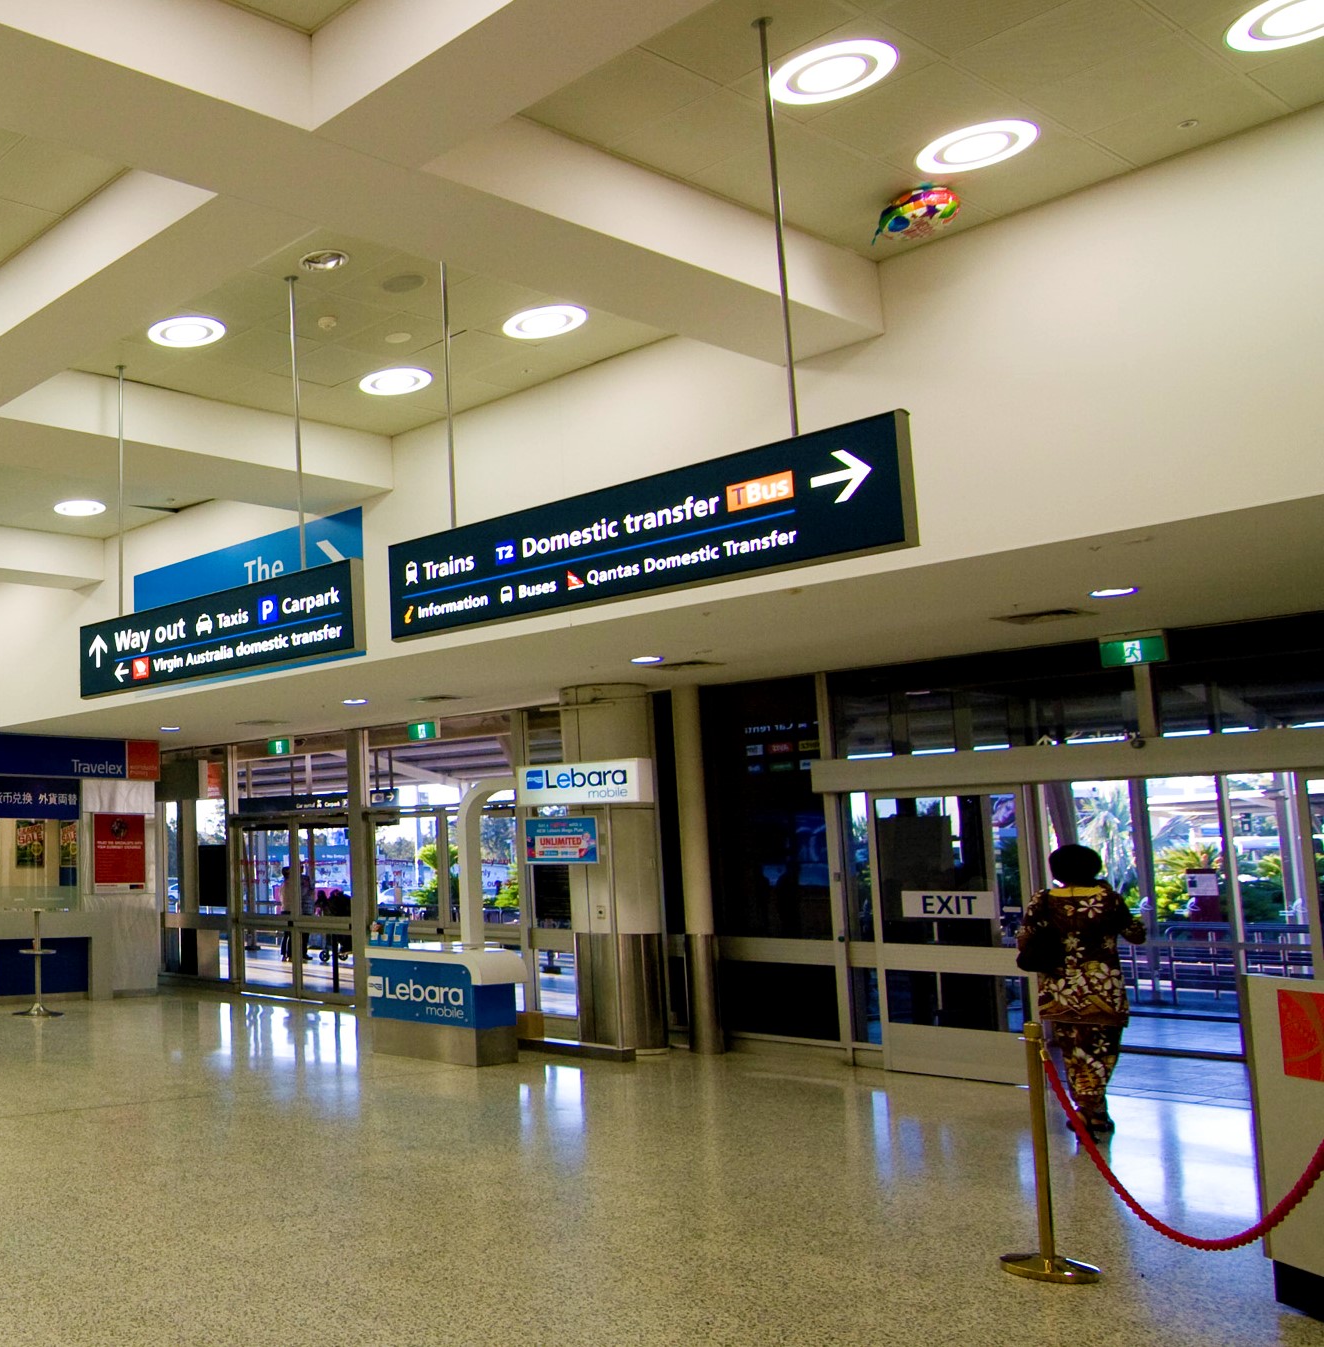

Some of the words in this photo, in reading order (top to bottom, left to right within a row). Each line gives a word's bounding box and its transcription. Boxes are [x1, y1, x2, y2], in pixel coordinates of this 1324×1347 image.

[422, 553, 475, 581] Trains
[496, 545, 515, 560] T2
[522, 519, 619, 558] Domestic
[624, 493, 720, 533] transfer
[732, 477, 790, 506] TBus
[244, 556, 284, 584] The
[417, 592, 488, 619] Information
[518, 579, 557, 598] Buses
[586, 560, 639, 586] Qantas
[643, 544, 719, 575] Domestic
[723, 529, 797, 557] Transfer
[114, 628, 151, 653] Way
[154, 618, 186, 644] out
[216, 608, 249, 629] Taxis
[261, 600, 274, 620] P
[281, 586, 340, 615] Carpark
[152, 655, 184, 673] Virgin
[185, 645, 234, 667] Australia
[235, 633, 289, 656] domestic
[290, 623, 343, 647] transfer
[71, 759, 123, 775] Travelex
[545, 768, 628, 789] Lebara
[38, 792, 78, 806] 外貨両替
[587, 787, 629, 799] mobile
[539, 837, 582, 846] UNLIMITED
[922, 895, 978, 915] EXIT
[385, 977, 464, 1006] Lebara
[425, 1005, 465, 1019] mobile
